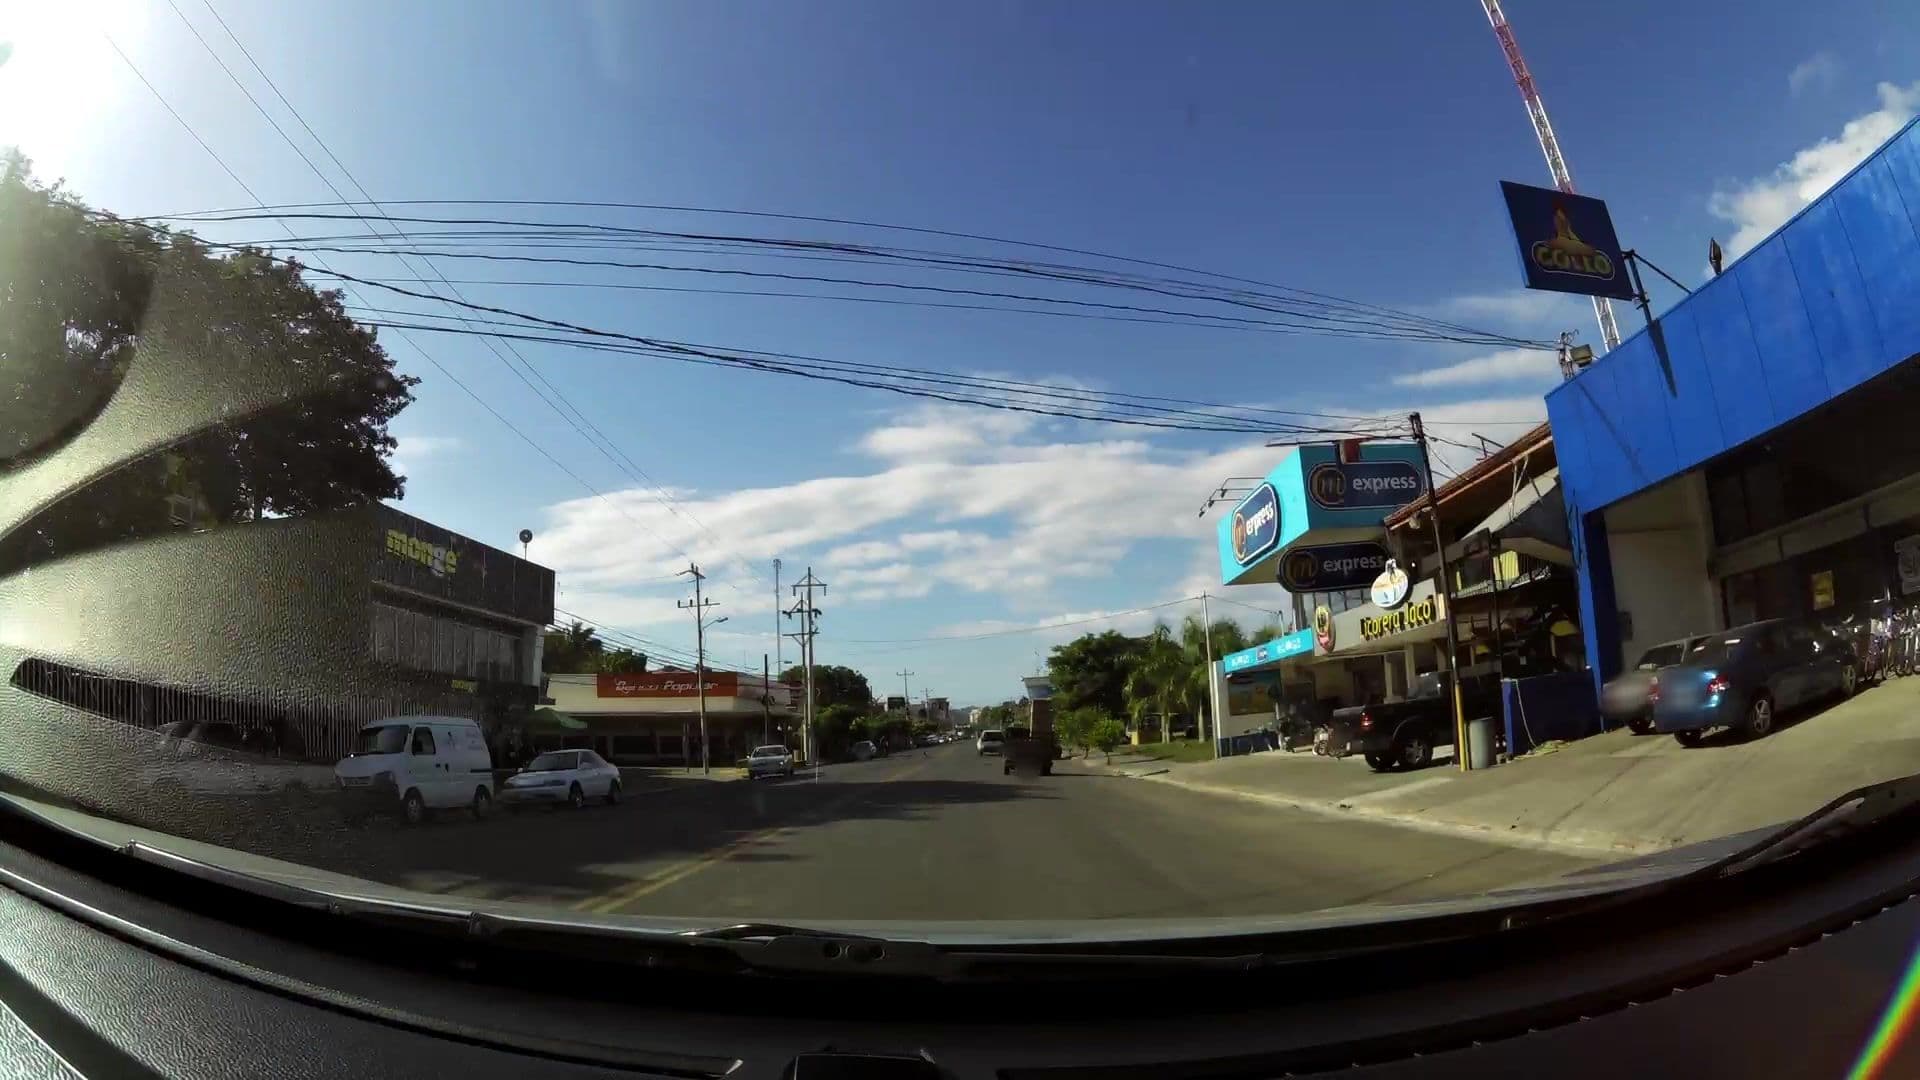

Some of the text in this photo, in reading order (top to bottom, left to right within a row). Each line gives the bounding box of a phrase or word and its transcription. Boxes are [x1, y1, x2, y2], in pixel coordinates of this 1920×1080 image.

[1352, 474, 1416, 494] express
[1246, 502, 1274, 536] express
[1323, 554, 1384, 576] express
[663, 680, 719, 693] Popuar
